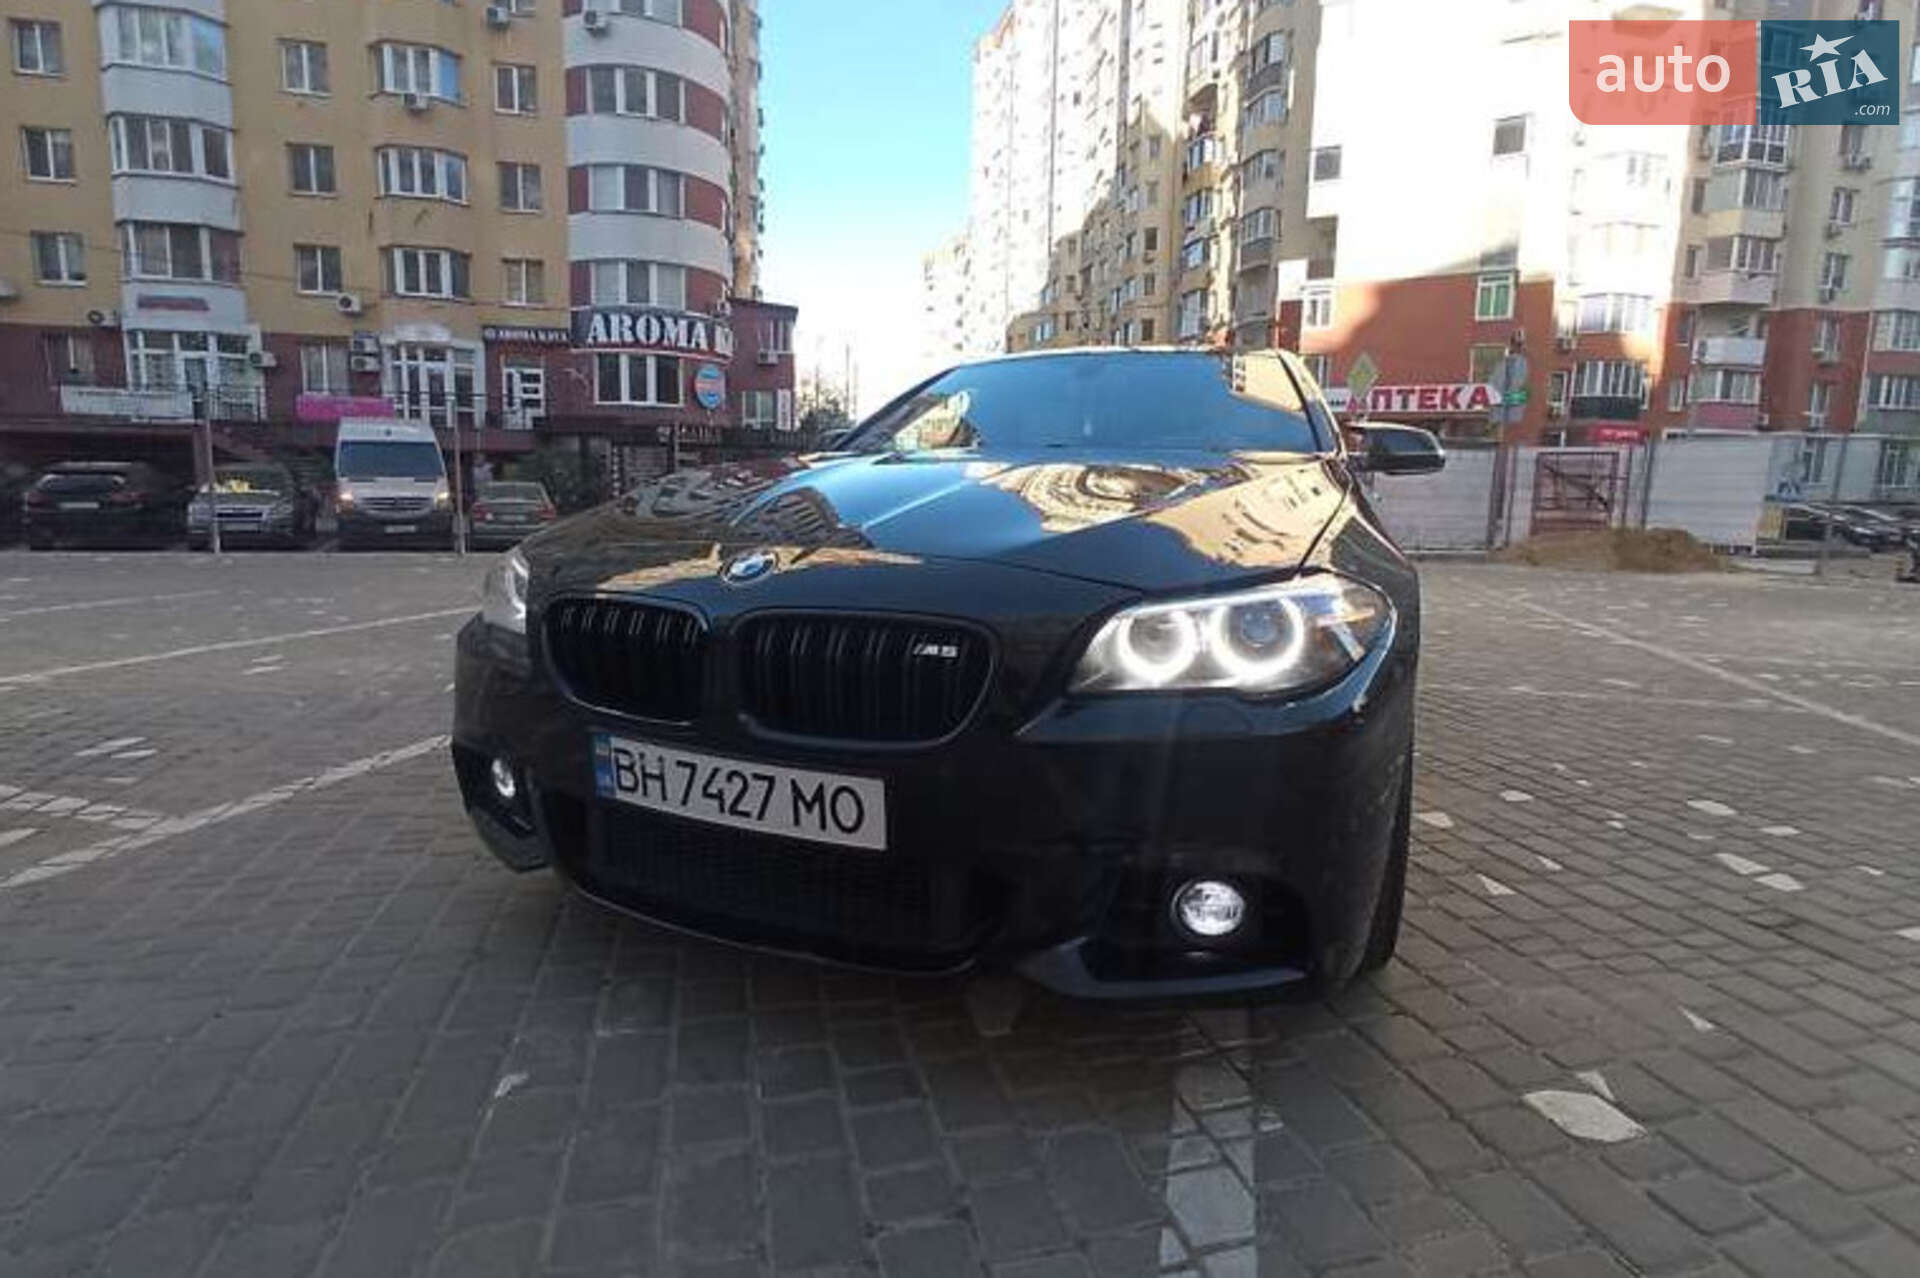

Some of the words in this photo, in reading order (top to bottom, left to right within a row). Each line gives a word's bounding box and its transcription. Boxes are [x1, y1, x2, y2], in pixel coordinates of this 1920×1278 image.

[586, 313, 709, 351] AROMA
[613, 748, 668, 802] BH
[675, 759, 776, 821] 7427
[790, 777, 865, 834] MO
